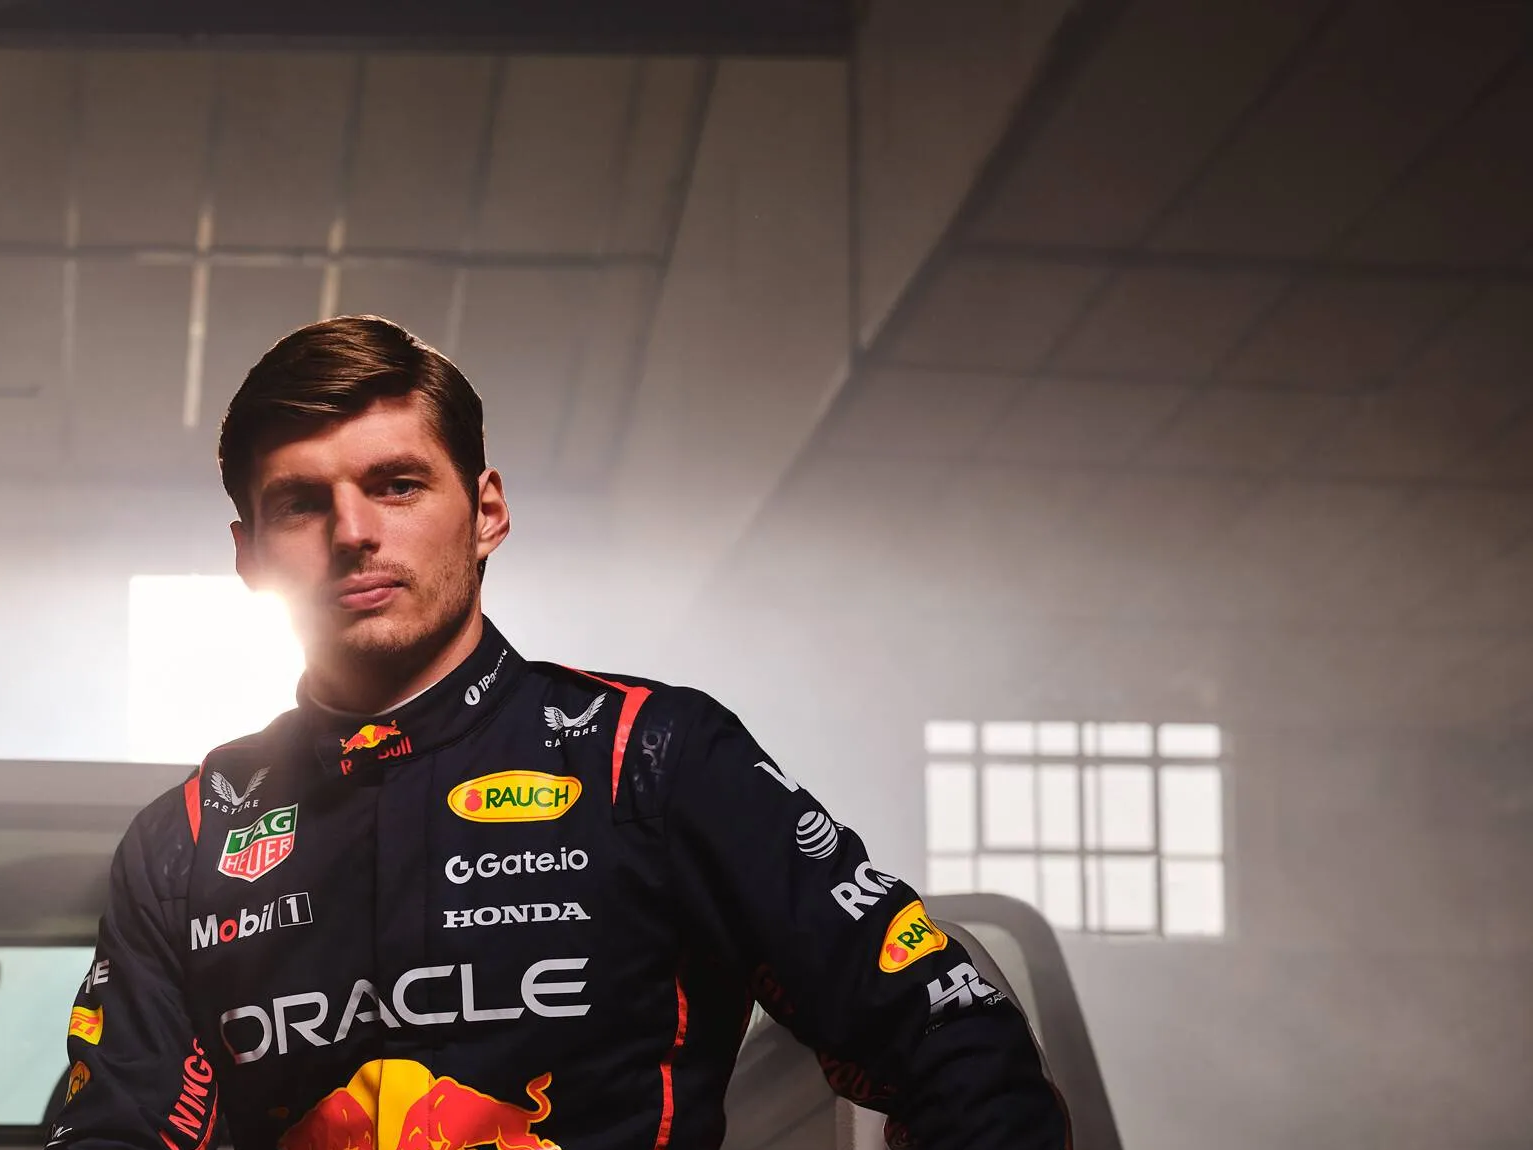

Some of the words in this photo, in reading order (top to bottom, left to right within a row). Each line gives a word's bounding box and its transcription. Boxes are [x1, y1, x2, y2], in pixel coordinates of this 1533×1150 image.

[544, 724, 598, 748] CATORE
[485, 785, 569, 809] RAUCH
[235, 811, 293, 849] TAG
[225, 838, 292, 875] HEUER
[475, 847, 589, 878] Gate.io
[190, 901, 275, 950] Mobil
[443, 902, 591, 929] HONDA
[219, 957, 591, 1065] ORACLE
